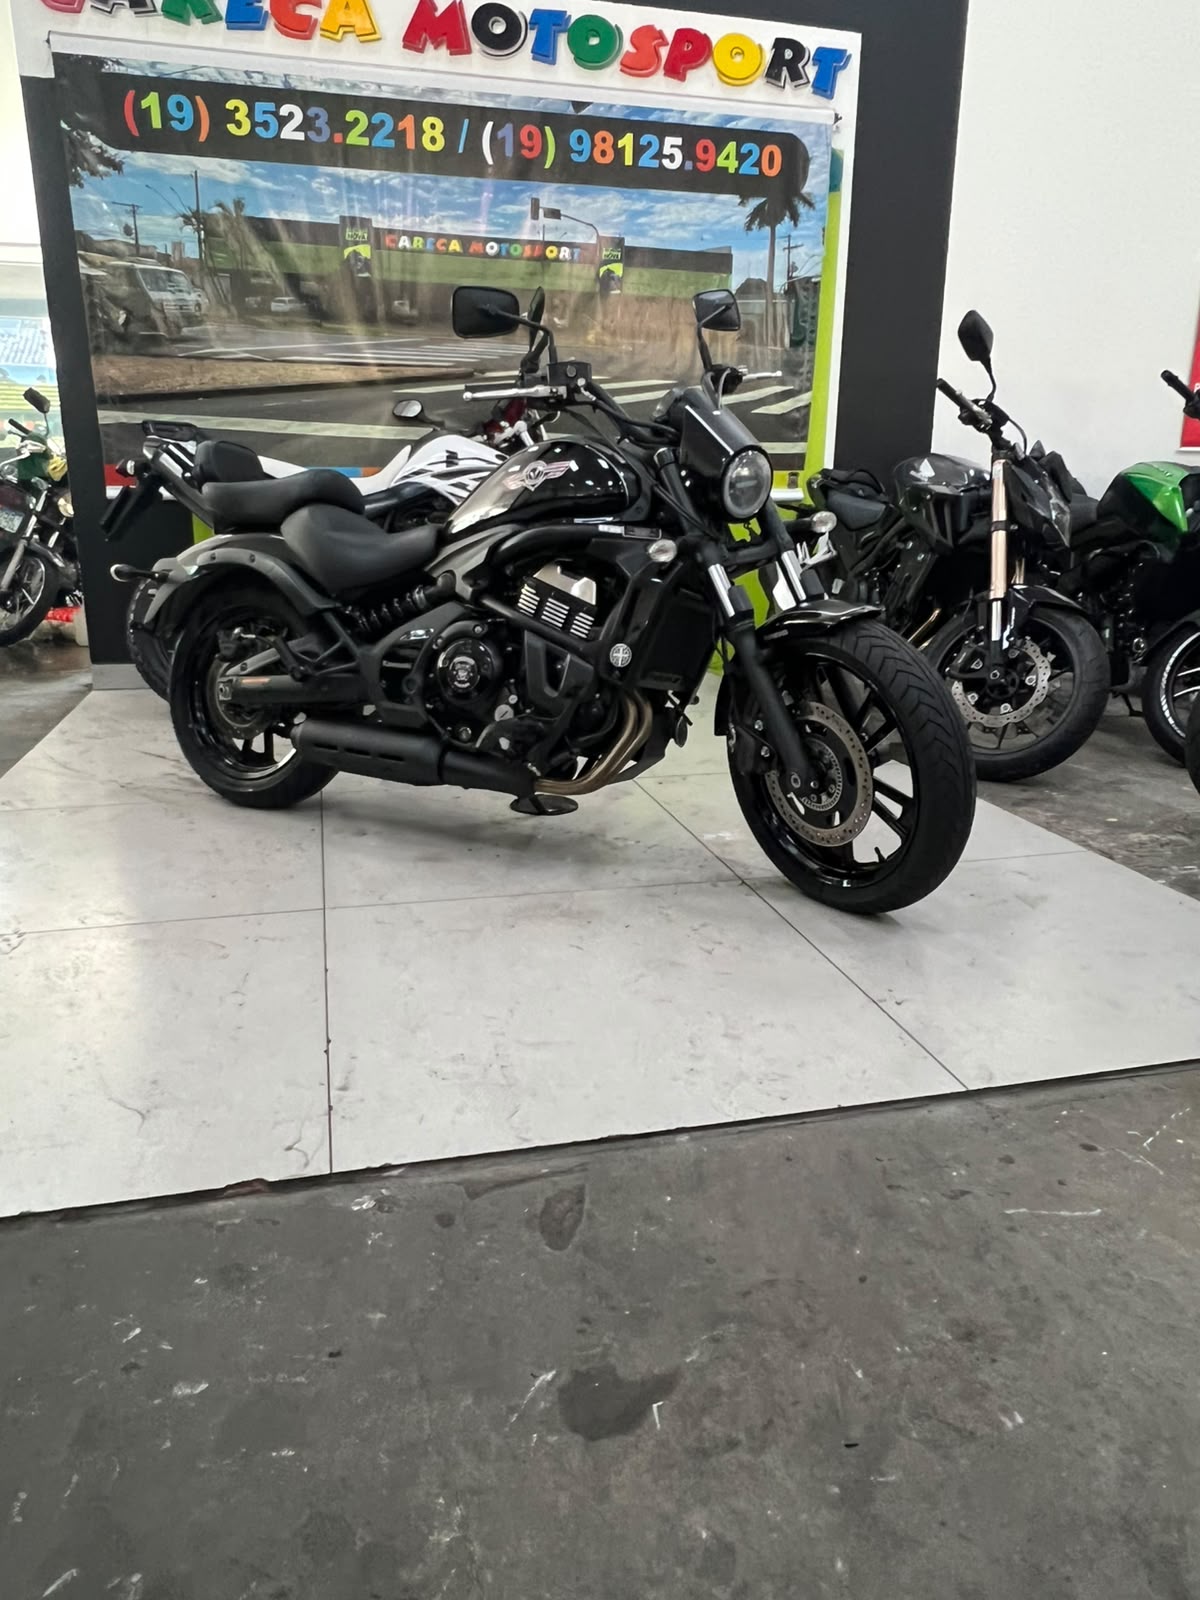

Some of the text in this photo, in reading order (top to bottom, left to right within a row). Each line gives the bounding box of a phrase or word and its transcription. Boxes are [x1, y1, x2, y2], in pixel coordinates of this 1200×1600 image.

[40, 0, 851, 100] ECA MOTOSPORT
[123, 89, 783, 178] (19) 3523.2218 / (19) 98125.9420
[384, 233, 463, 253] CARECA
